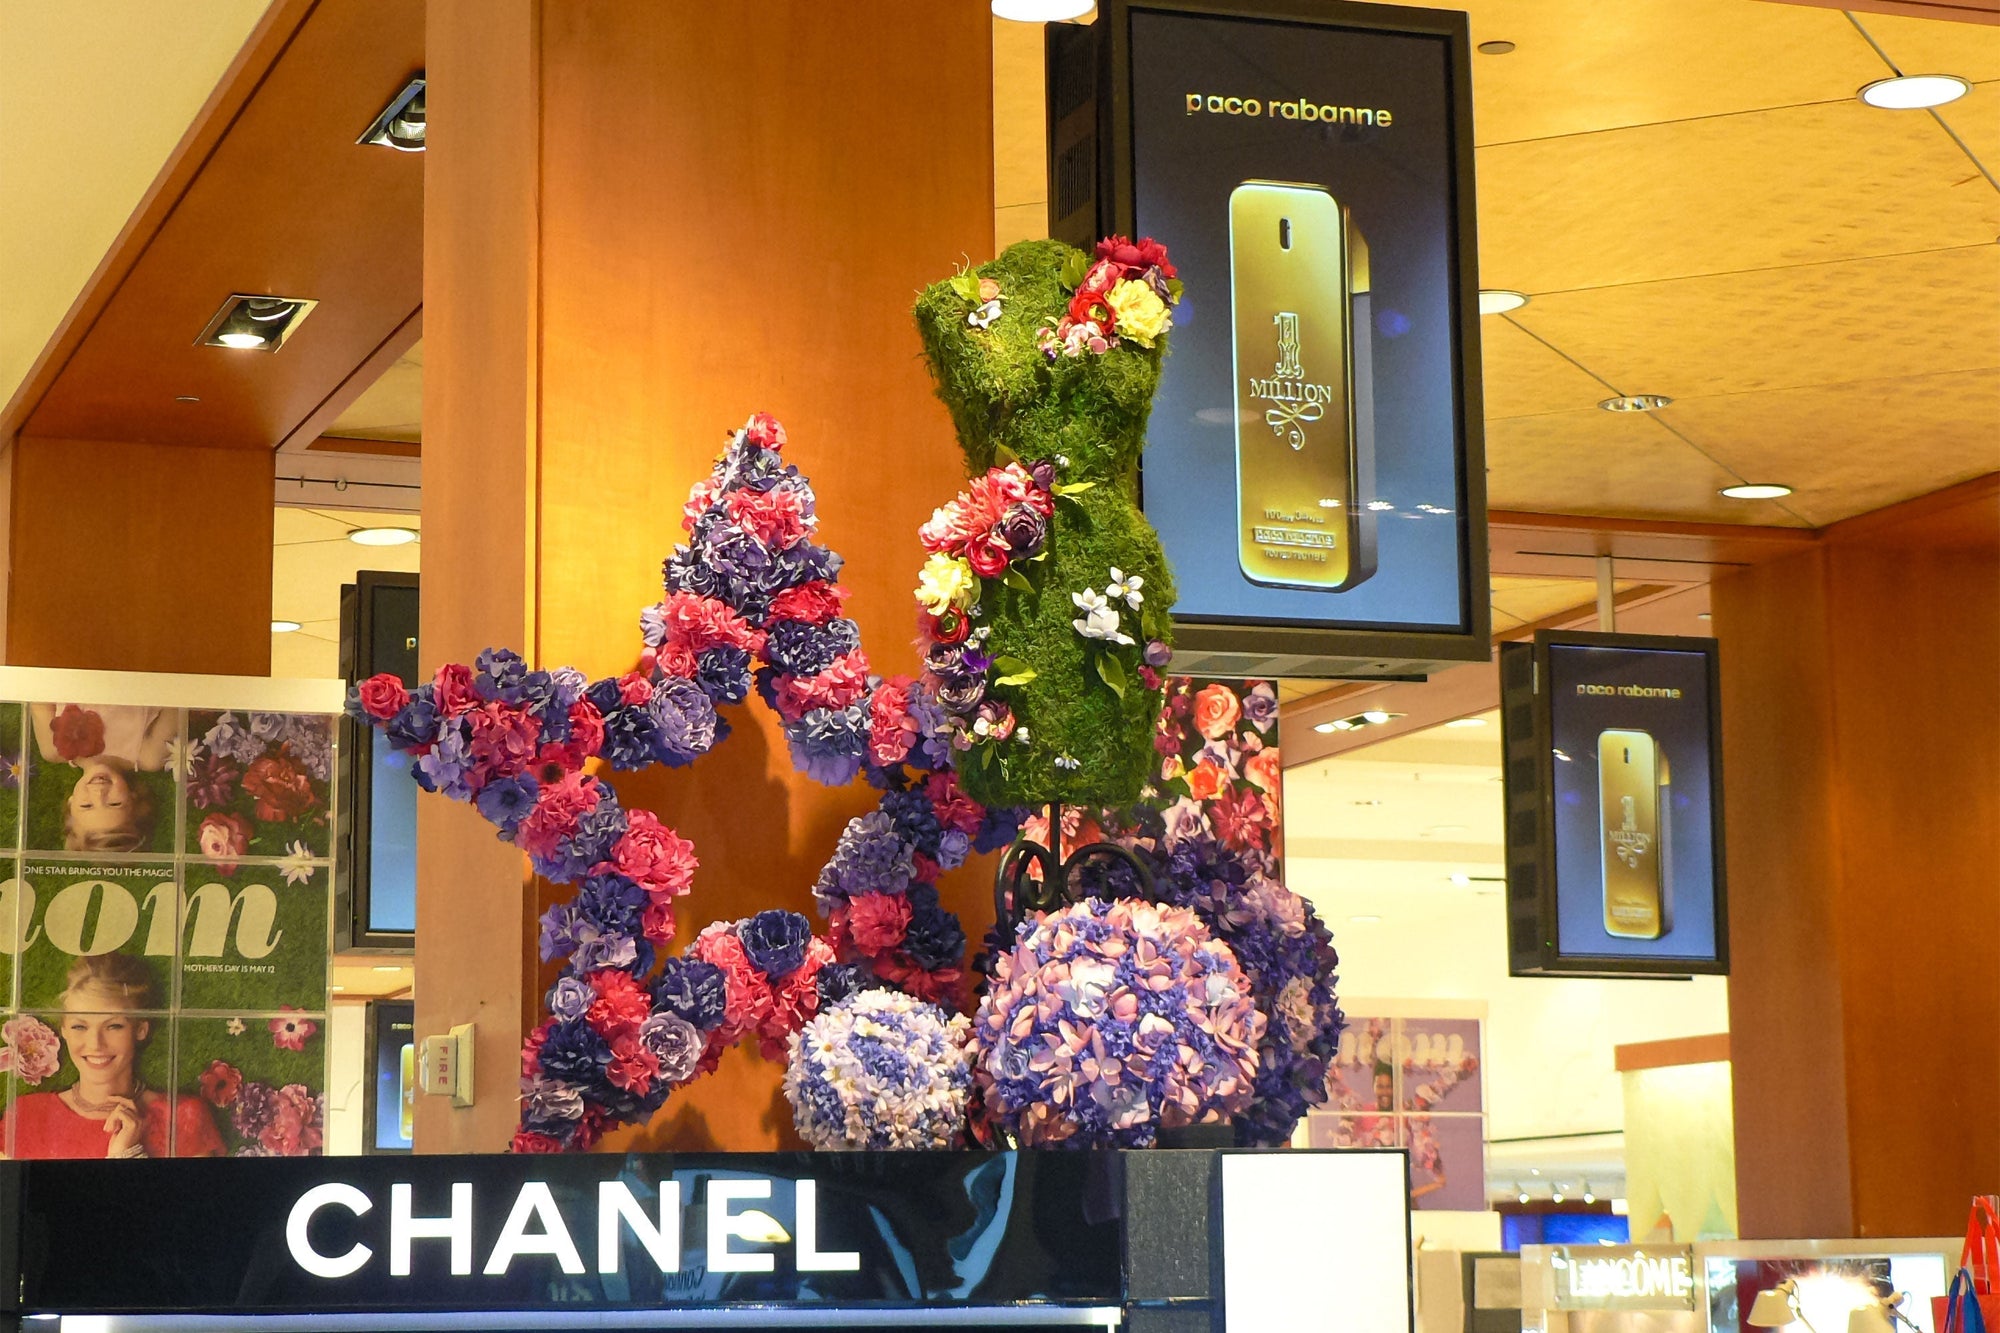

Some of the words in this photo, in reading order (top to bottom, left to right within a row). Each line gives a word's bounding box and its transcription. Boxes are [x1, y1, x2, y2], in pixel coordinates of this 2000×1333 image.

[1185, 93, 1262, 117] paco
[1268, 98, 1393, 128] rabanne
[1273, 311, 1304, 379] 1
[1249, 377, 1332, 404] MILLION
[1576, 683, 1616, 696] paco
[1617, 684, 1682, 699] rabanne
[23, 865, 44, 875] ONE
[45, 866, 67, 875] STAR
[68, 866, 100, 876] BRINGS
[100, 867, 123, 876] YOU
[123, 867, 143, 877] THE
[143, 868, 174, 878] MAGIC
[224, 964, 240, 974] DAY
[241, 964, 248, 974] IS
[249, 964, 267, 974] MAY
[267, 965, 275, 974] 12
[438, 1045, 449, 1086] FIRE
[285, 1178, 861, 1279] CHANEL
